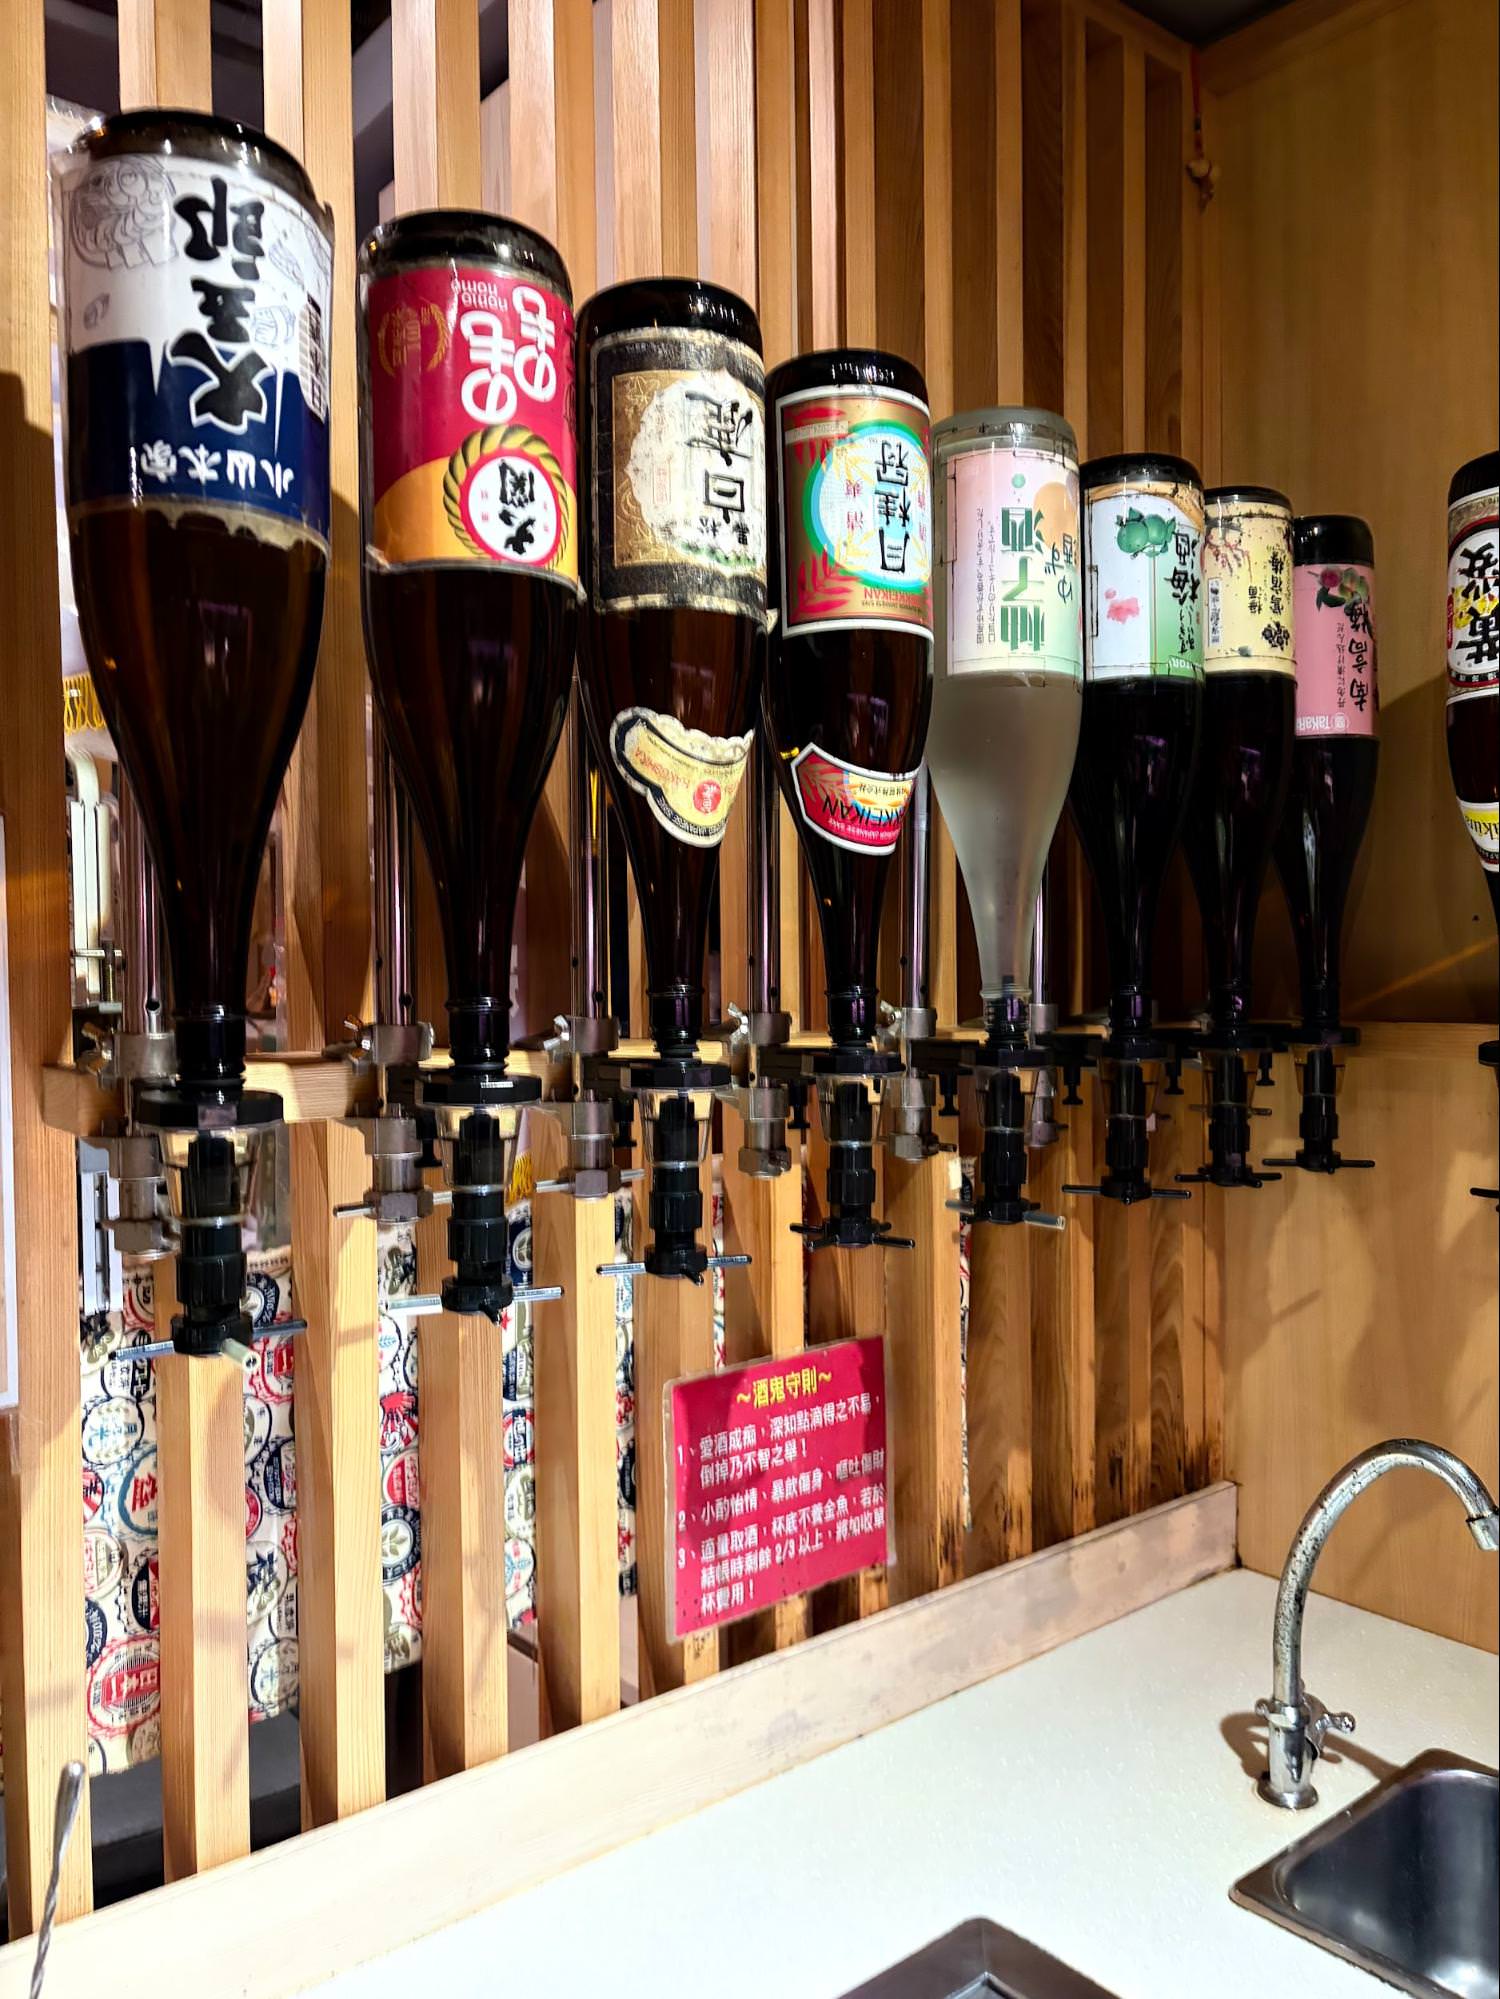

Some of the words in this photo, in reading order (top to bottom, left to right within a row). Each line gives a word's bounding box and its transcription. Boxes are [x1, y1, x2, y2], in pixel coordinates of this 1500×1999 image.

[139, 440, 294, 498] 小山本家
[498, 458, 536, 555] 大関
[684, 390, 753, 524] 白鹿
[874, 440, 911, 574] 月桂冠
[1000, 507, 1046, 652] 柚子酒
[1164, 531, 1200, 606] 梅酒
[1347, 602, 1369, 711] 南高梅
